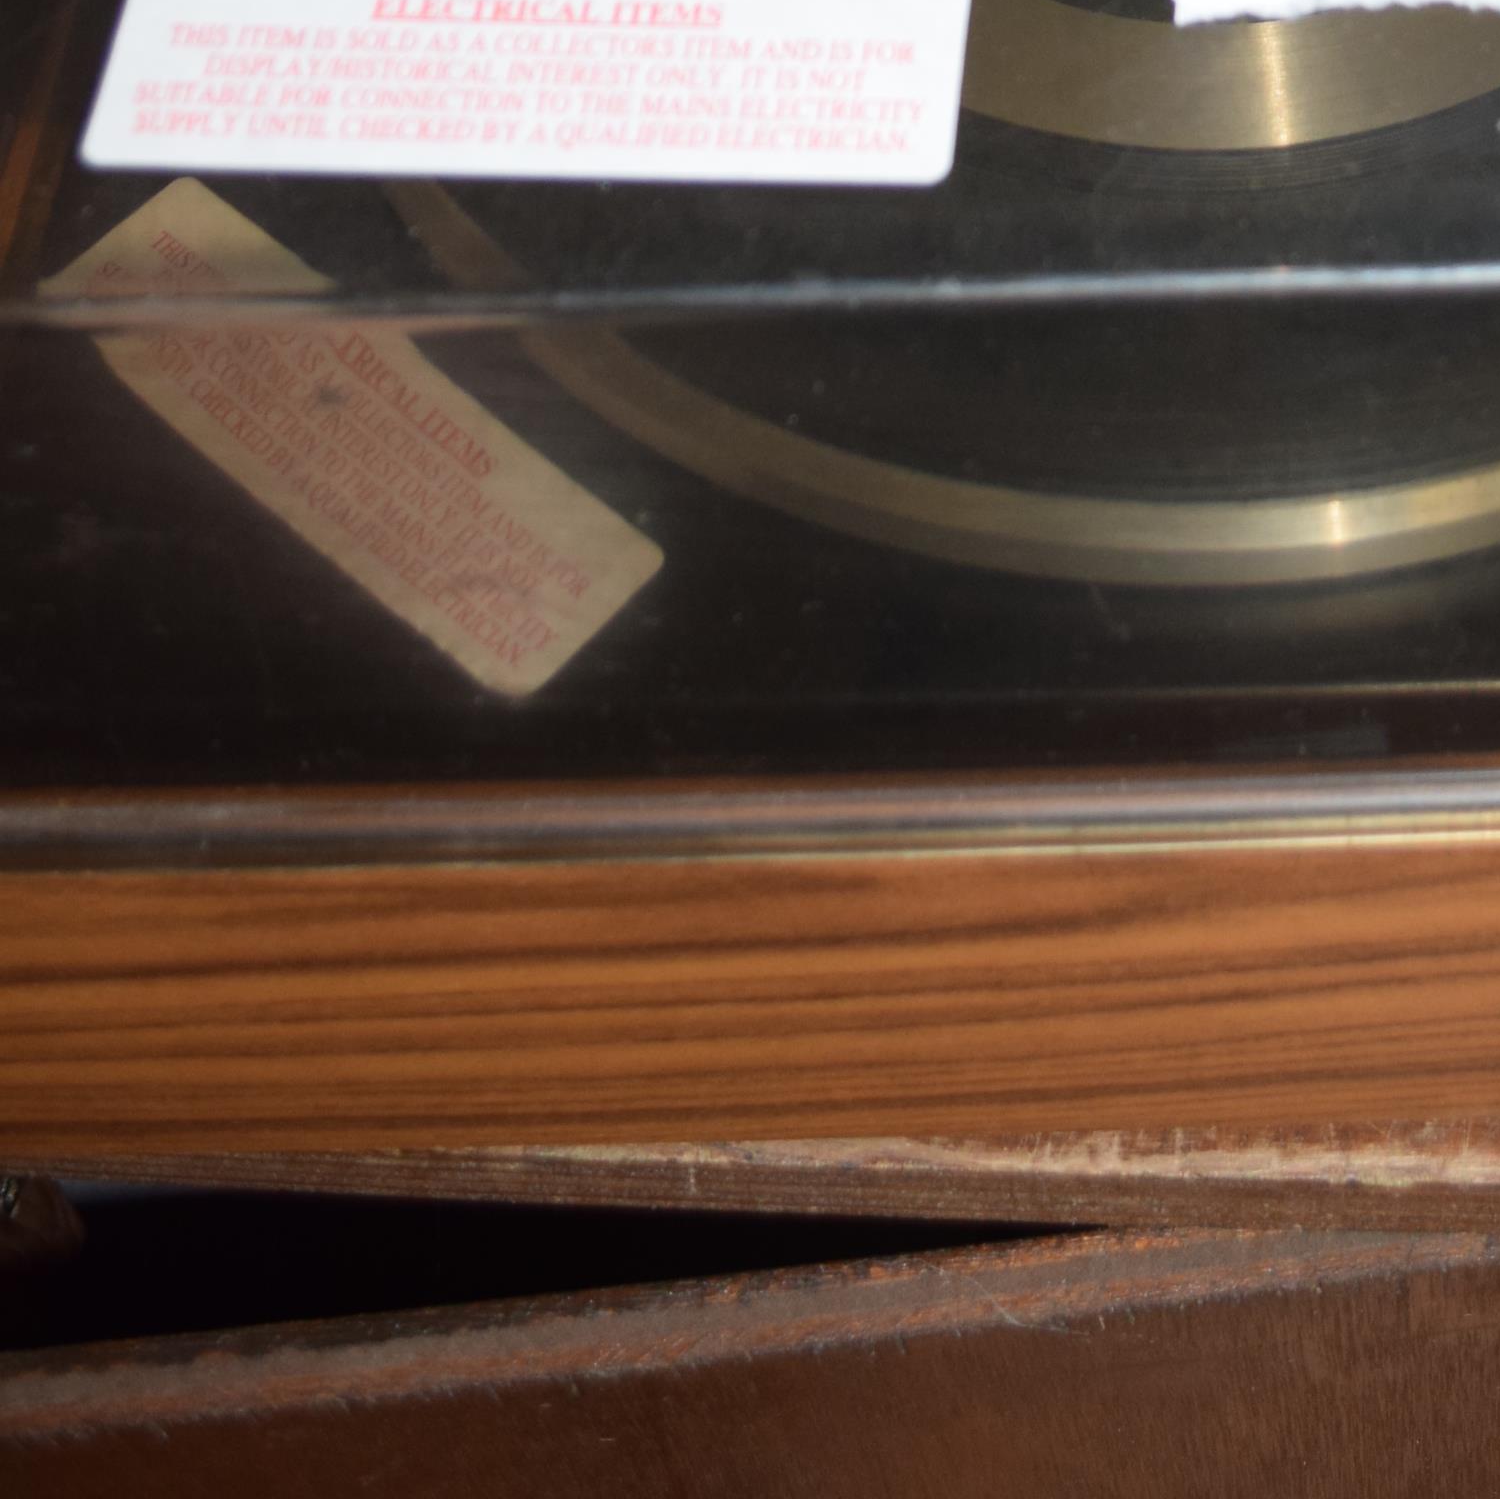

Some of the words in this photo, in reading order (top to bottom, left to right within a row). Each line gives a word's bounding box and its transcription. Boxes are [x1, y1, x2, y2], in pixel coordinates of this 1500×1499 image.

[611, 0, 725, 27] ITEMS
[236, 23, 308, 49] ITEM
[416, 404, 499, 483] ITEMS
